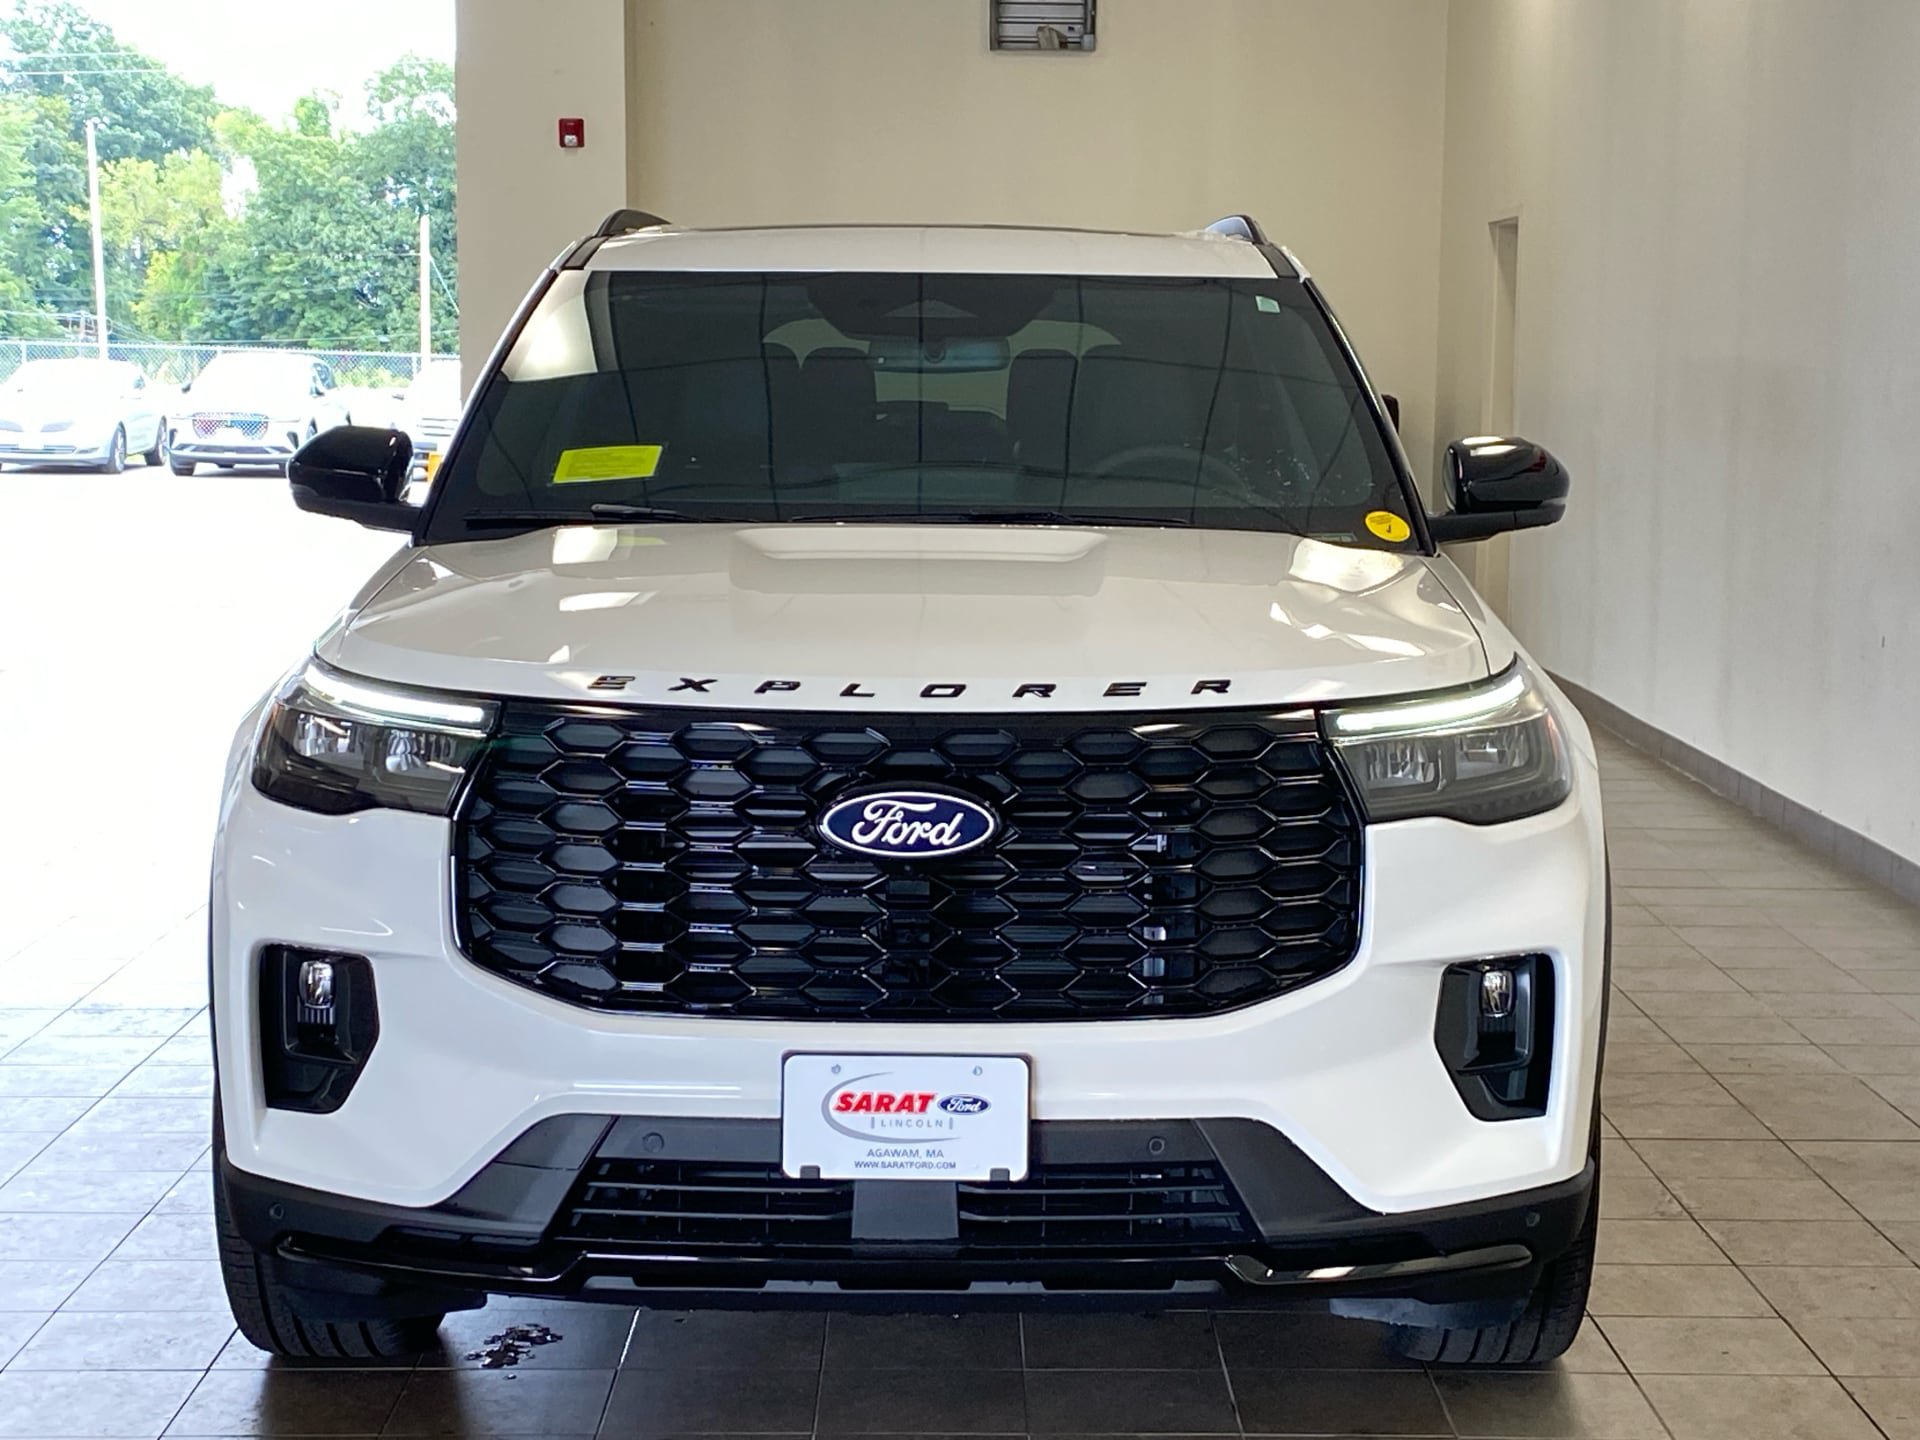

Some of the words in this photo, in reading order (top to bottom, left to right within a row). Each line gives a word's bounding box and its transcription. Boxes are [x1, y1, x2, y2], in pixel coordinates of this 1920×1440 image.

[587, 674, 1233, 699] EXPLORER
[850, 798, 964, 848] Ford
[834, 1092, 936, 1114] SARAT
[945, 1096, 983, 1113] Ford
[880, 1118, 944, 1129] LINCOLN
[866, 1149, 922, 1159] AGAWAM,
[925, 1149, 945, 1159] MA
[854, 1160, 957, 1170] WWW.SARATFORD.COM
